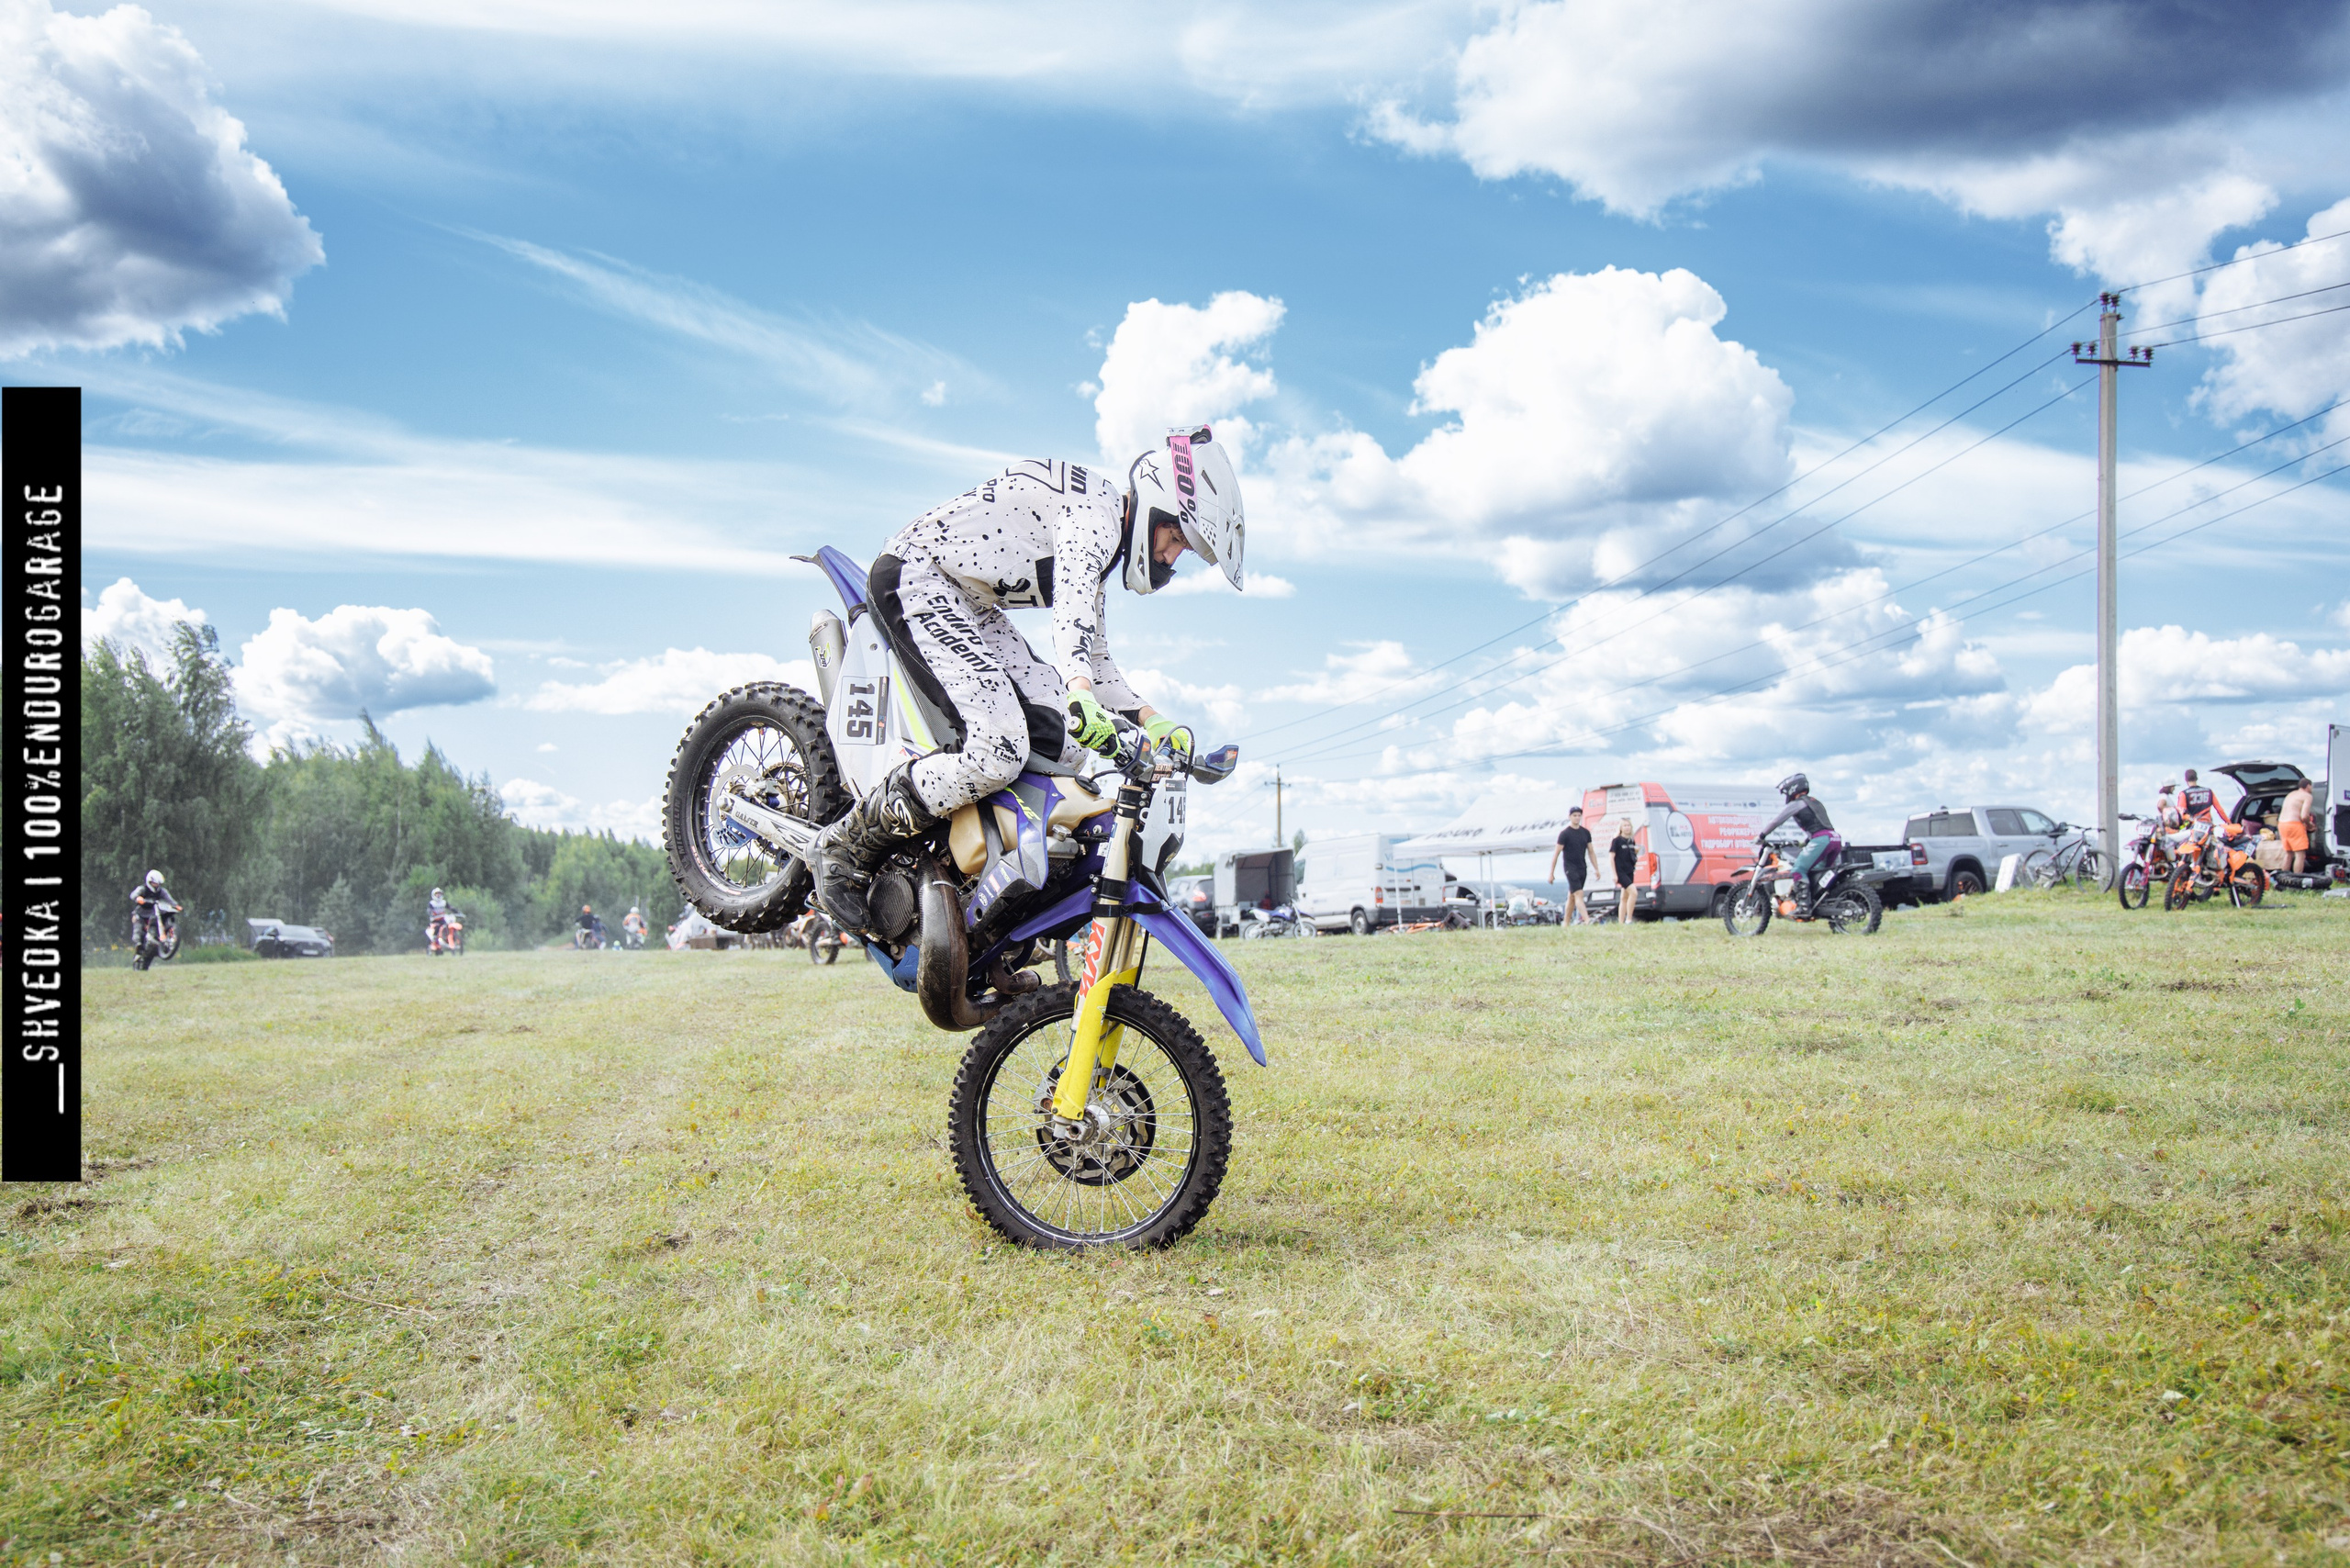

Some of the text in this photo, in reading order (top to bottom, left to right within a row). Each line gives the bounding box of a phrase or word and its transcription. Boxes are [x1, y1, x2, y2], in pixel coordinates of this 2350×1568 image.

[1172, 442, 1198, 524] 100%
[912, 612, 999, 673] Academy
[927, 595, 983, 646] Enduro
[846, 683, 876, 738] 145
